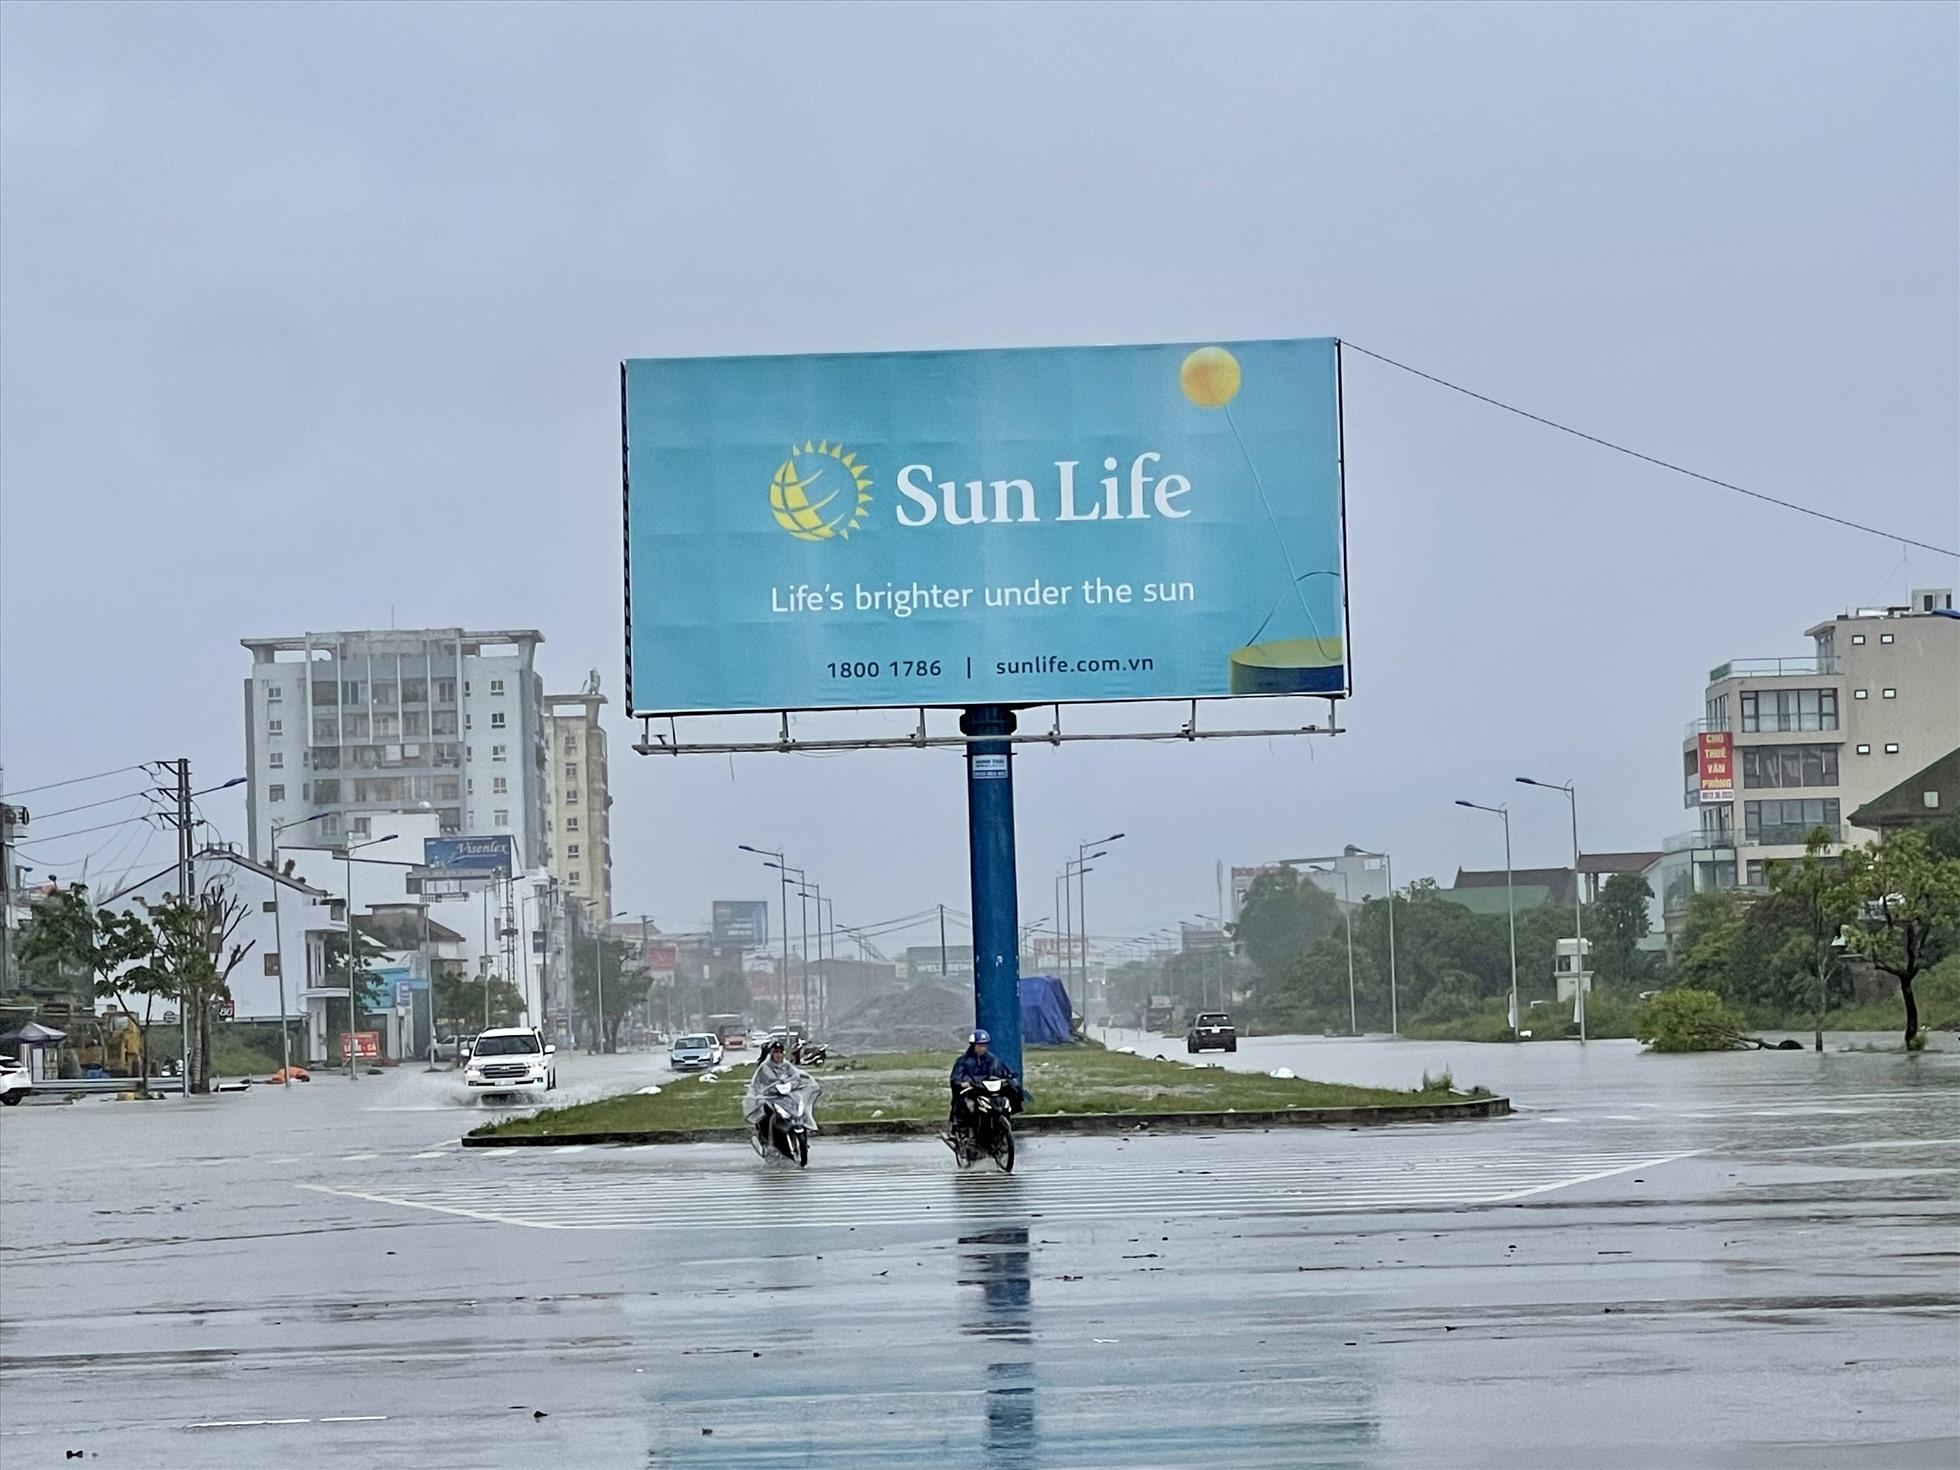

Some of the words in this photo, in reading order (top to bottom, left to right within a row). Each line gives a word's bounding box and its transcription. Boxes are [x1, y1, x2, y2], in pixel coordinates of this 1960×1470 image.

[896, 464, 1041, 527] Sun
[1054, 452, 1192, 522] Life
[771, 583, 845, 613] Life's
[855, 581, 974, 617] brighter
[984, 578, 1073, 607] under
[1081, 576, 1133, 604] the
[1143, 580, 1195, 602] sun
[826, 661, 880, 678] 1800
[889, 660, 942, 677] 1786
[996, 655, 1154, 675] sunlife.com.vn
